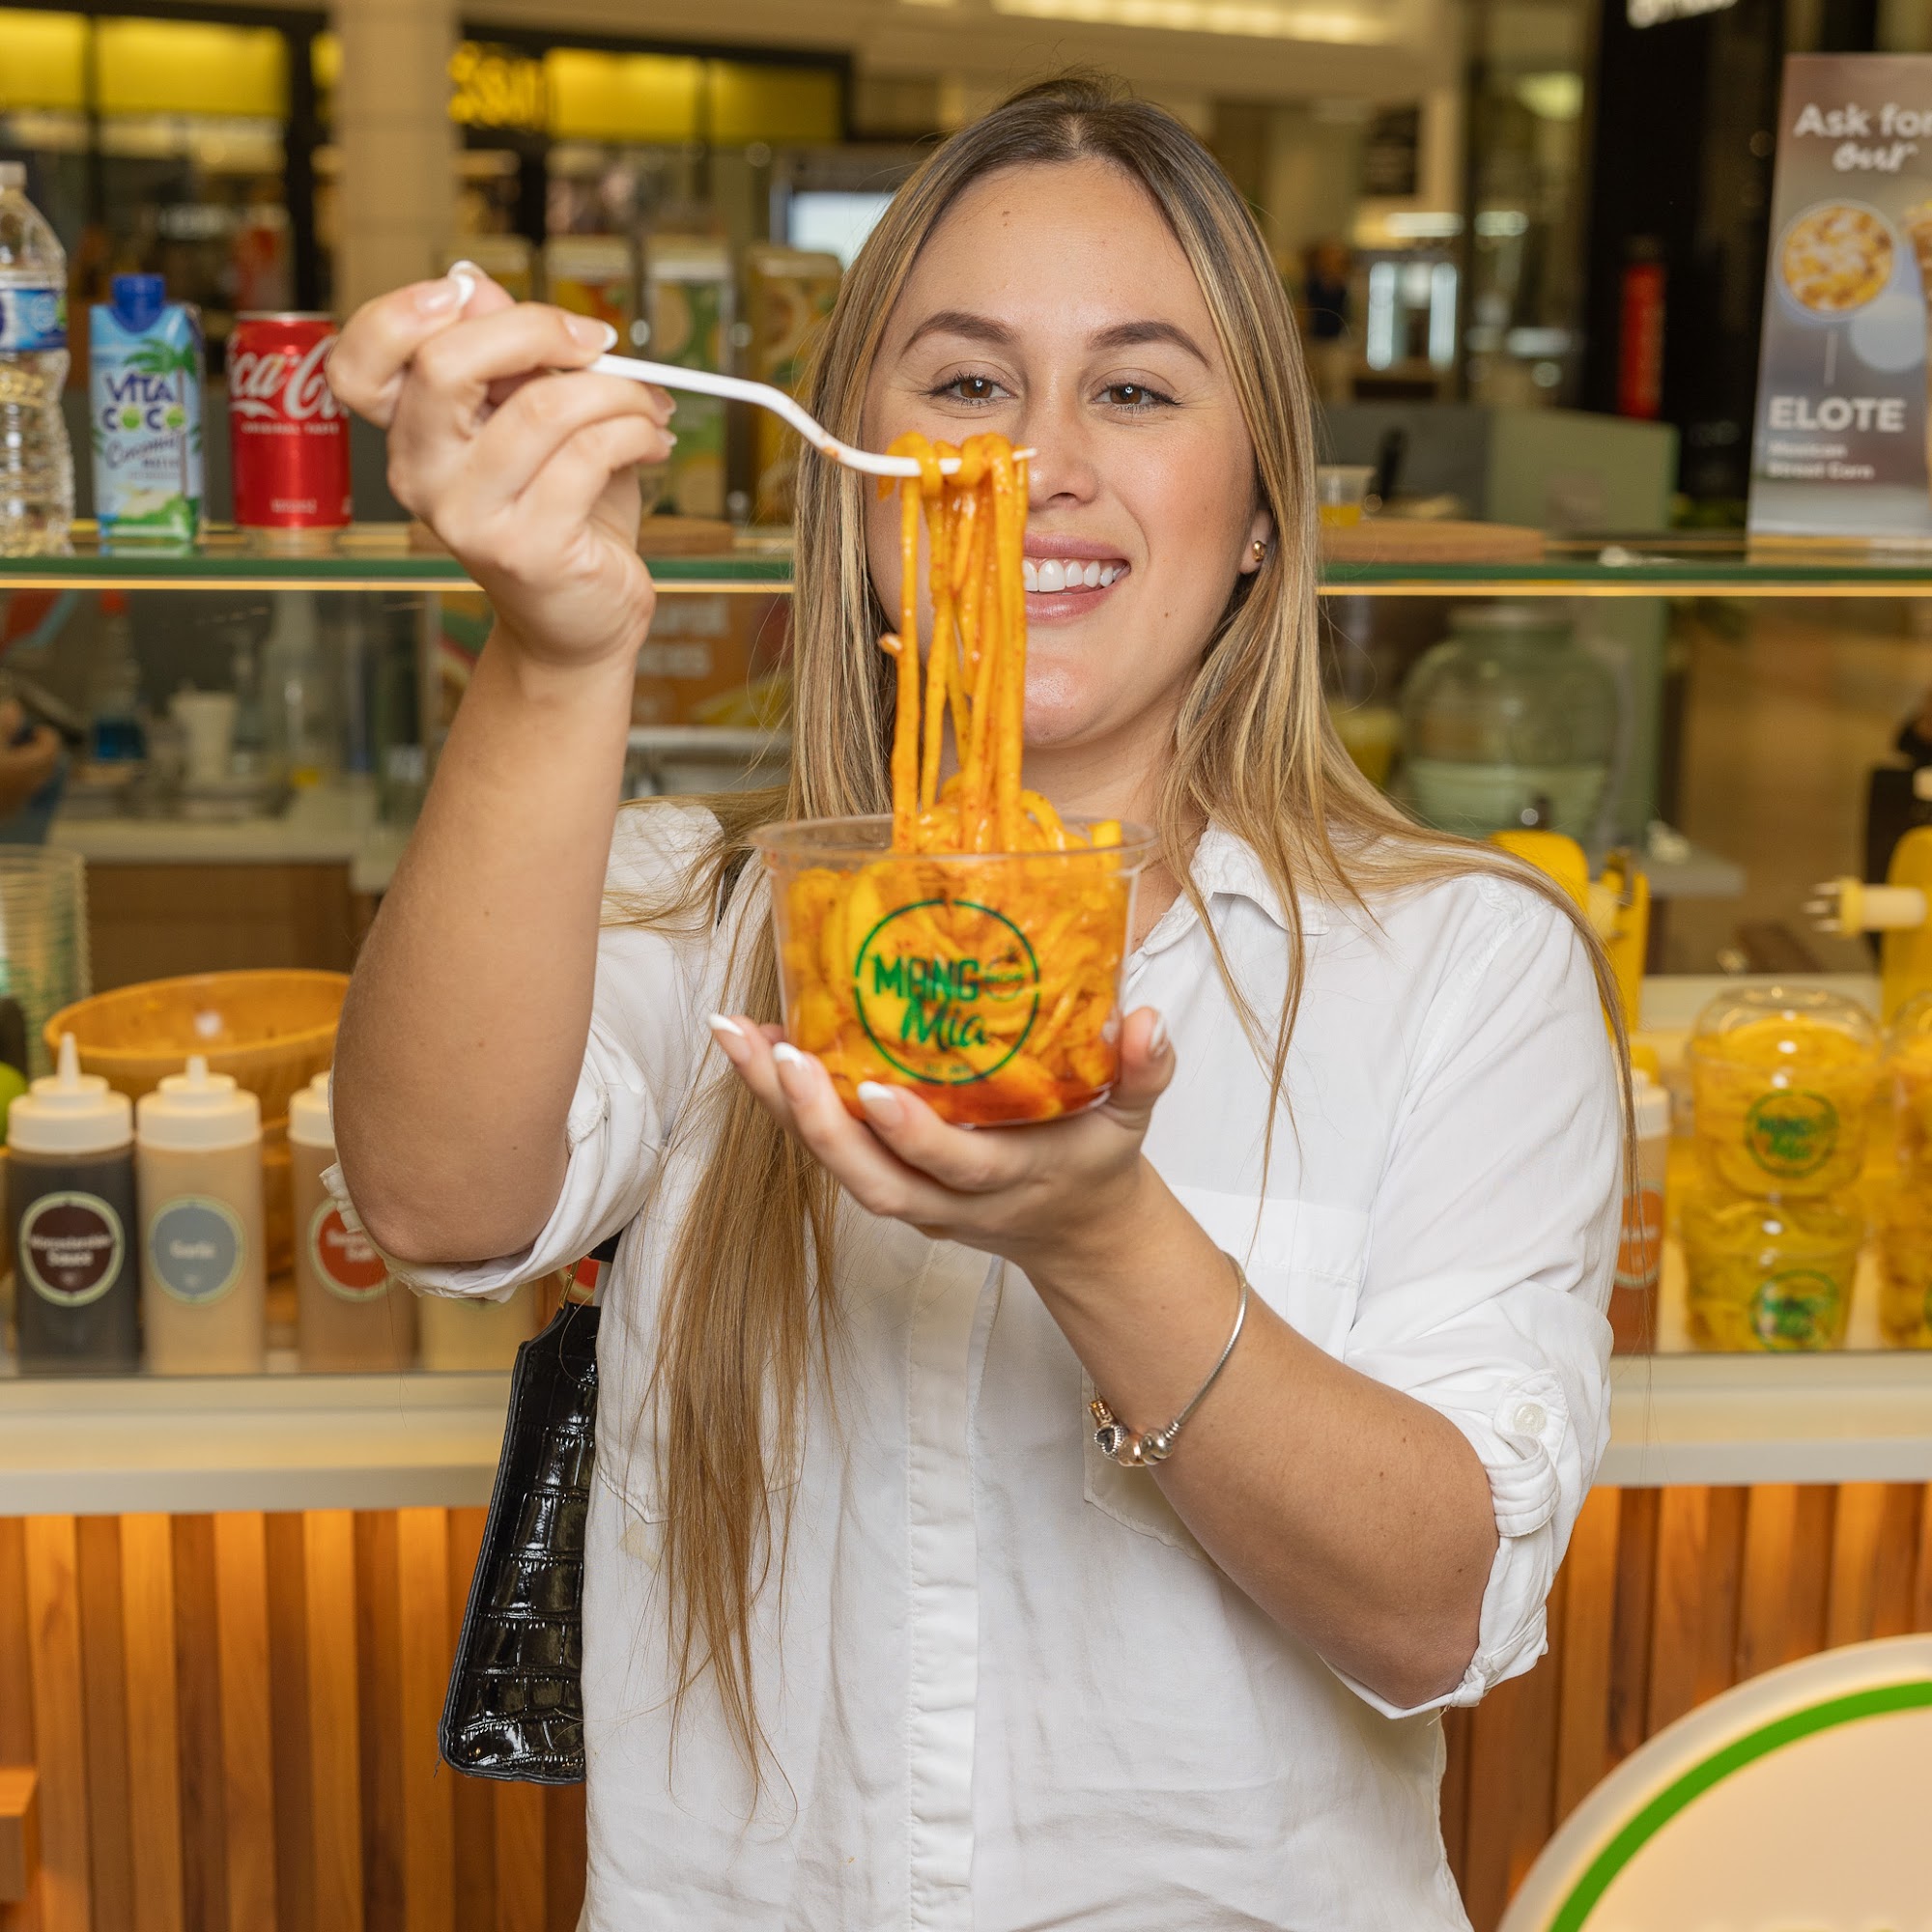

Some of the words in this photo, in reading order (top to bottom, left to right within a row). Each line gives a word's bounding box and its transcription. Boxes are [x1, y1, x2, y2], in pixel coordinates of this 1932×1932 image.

[1793, 102, 1870, 137] Ask
[104, 373, 175, 402] VITA
[102, 405, 185, 431] COCO
[1769, 395, 1907, 433] ELOTE
[900, 992, 986, 1052] Mia
